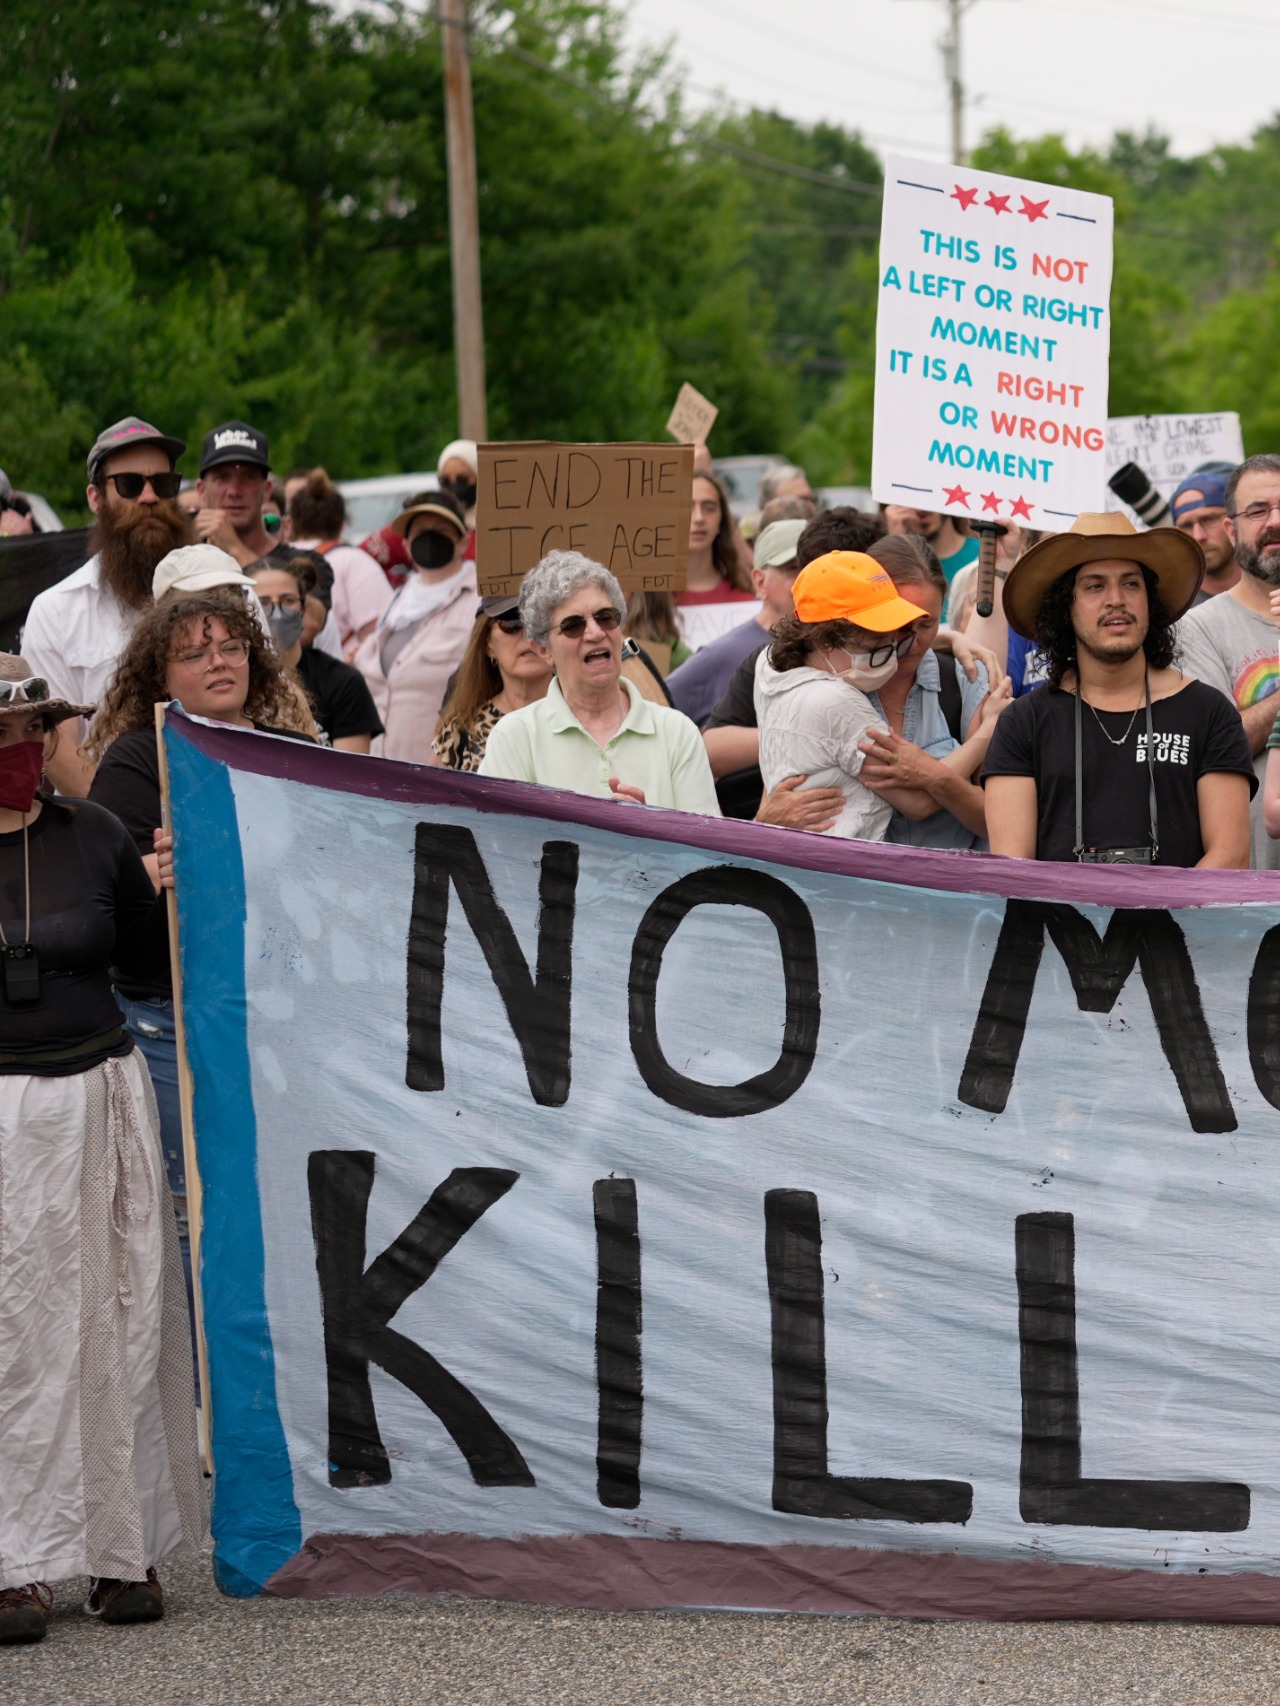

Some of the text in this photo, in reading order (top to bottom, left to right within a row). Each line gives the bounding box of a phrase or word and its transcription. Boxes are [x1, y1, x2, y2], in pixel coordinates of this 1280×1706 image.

[920, 229, 1088, 284] THIS IS NOT
[882, 266, 1104, 329] A LEFT OR RIGHT
[930, 316, 1058, 362] MOMENT
[889, 350, 1084, 408] IT IS A RIGHT
[939, 402, 978, 430] OR
[991, 411, 1104, 451] WRONG
[494, 452, 679, 510] END THE
[928, 440, 1054, 483] MOMENT
[608, 524, 676, 571] AGE
[479, 574, 674, 596] FDT FDT
[1136, 748, 1188, 765] BUES
[1137, 732, 1190, 747] HOUSE
[1158, 742, 1170, 750] OF
[406, 822, 822, 1118] NO
